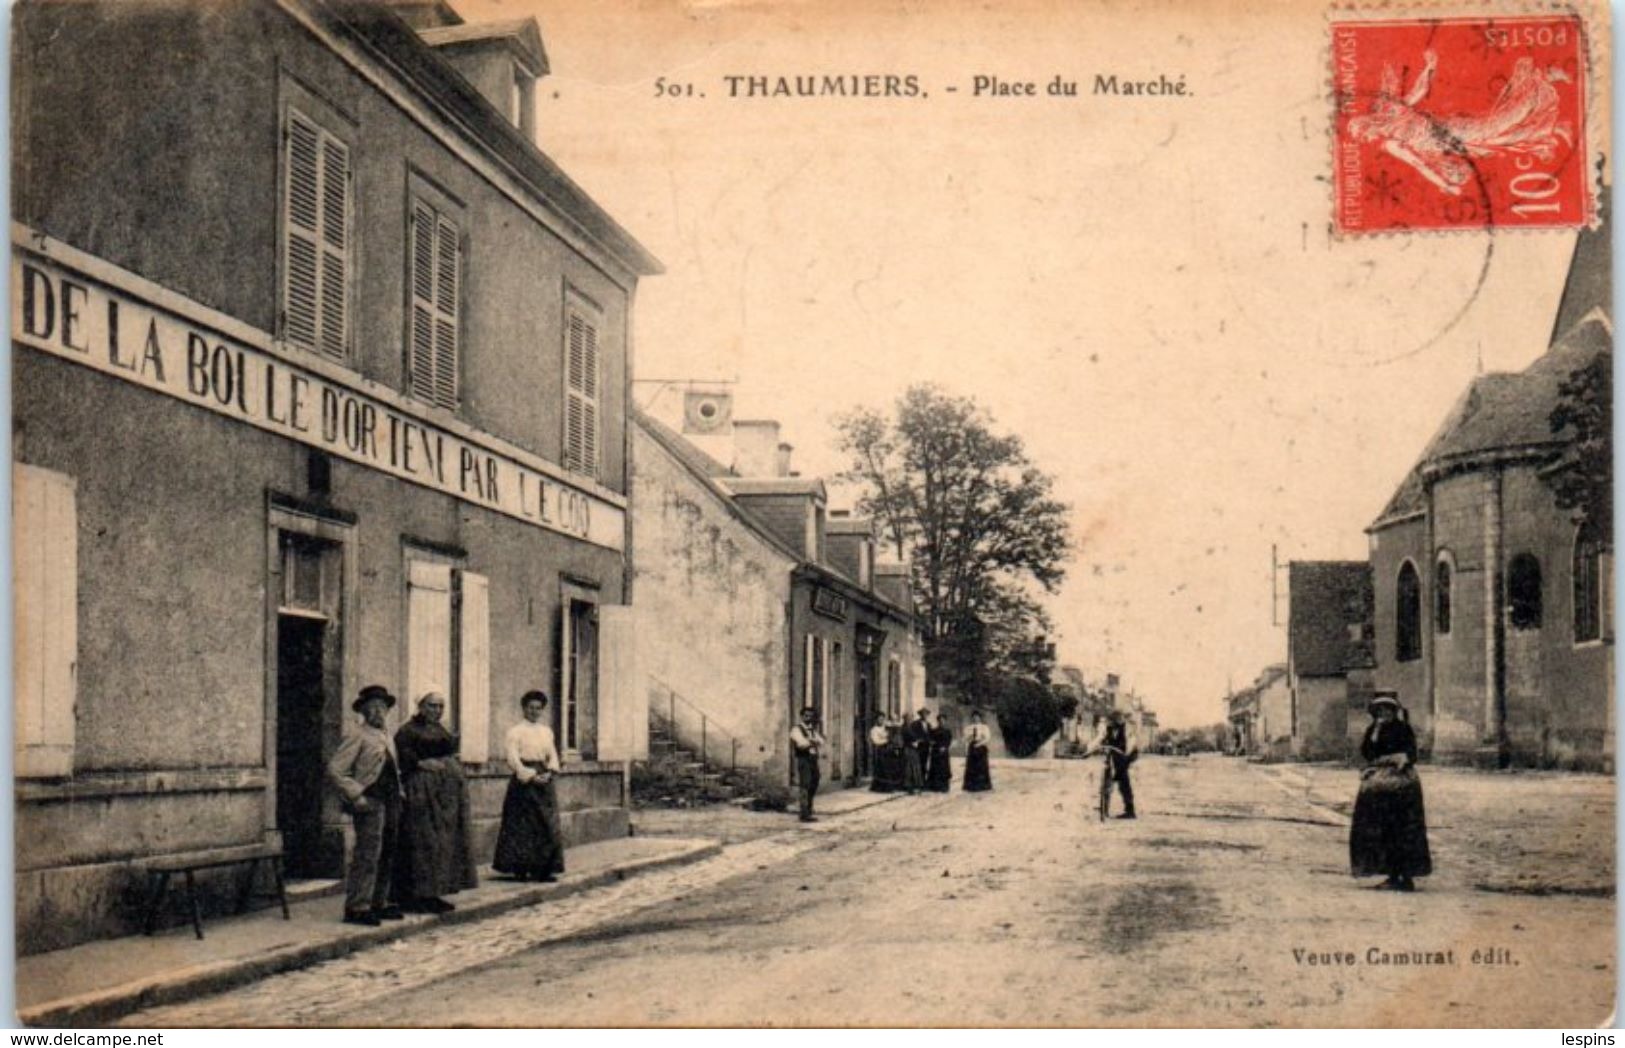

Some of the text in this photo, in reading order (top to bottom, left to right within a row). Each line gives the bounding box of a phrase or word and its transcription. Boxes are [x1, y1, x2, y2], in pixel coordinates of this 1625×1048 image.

[1485, 26, 1568, 48] POSTES
[655, 77, 705, 97] 501.
[723, 75, 928, 98] THAUMIERS.
[973, 75, 1036, 97] Place
[1047, 75, 1077, 96] du
[1094, 74, 1193, 96] Marché.
[22, 265, 90, 353] DE
[108, 301, 165, 384] LA
[187, 330, 310, 432] BOULE
[321, 387, 378, 459] D'OR
[460, 446, 499, 502] PAR
[1292, 947, 1519, 966] Veuve Camurat édit.
